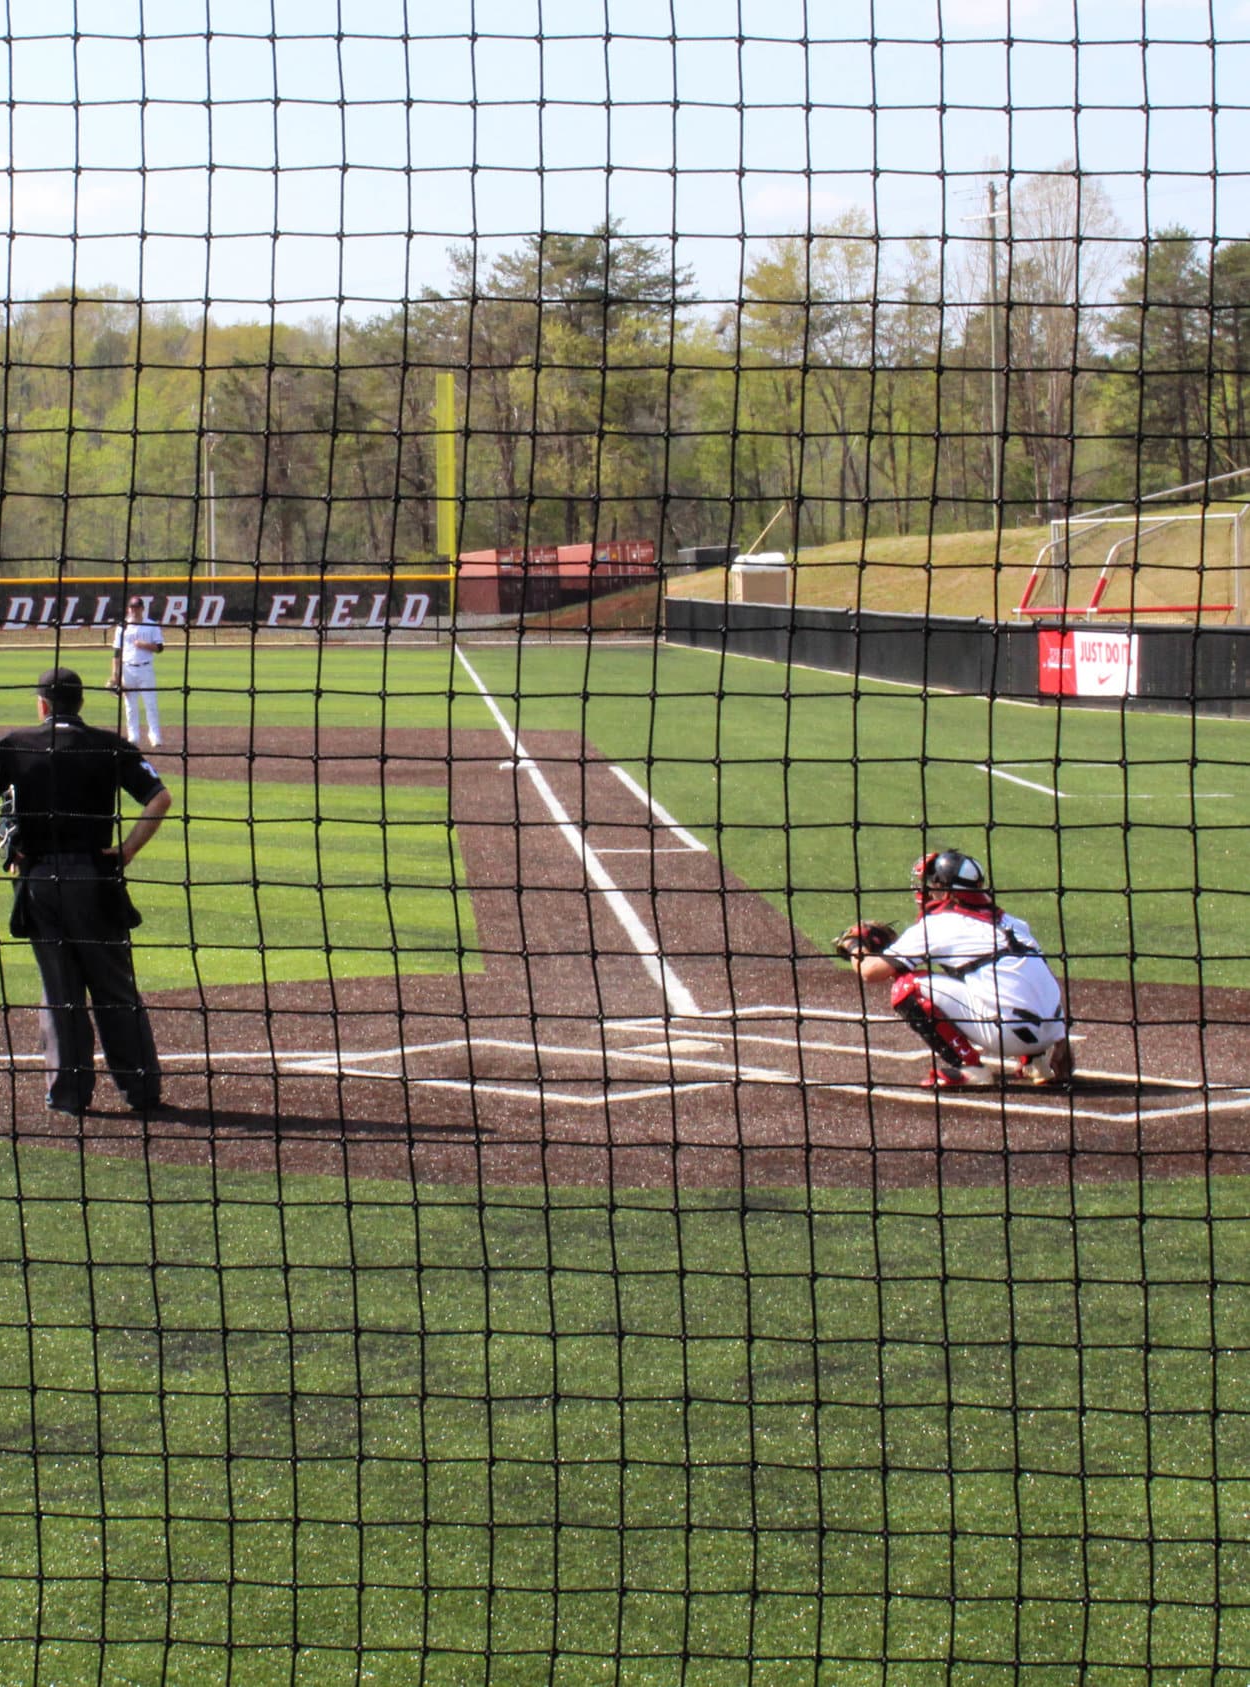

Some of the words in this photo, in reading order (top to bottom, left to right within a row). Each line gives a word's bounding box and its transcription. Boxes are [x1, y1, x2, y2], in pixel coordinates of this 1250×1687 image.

[266, 594, 429, 627] FIELD
[1080, 641, 1103, 663] JUST
[1105, 642, 1119, 664] DO
